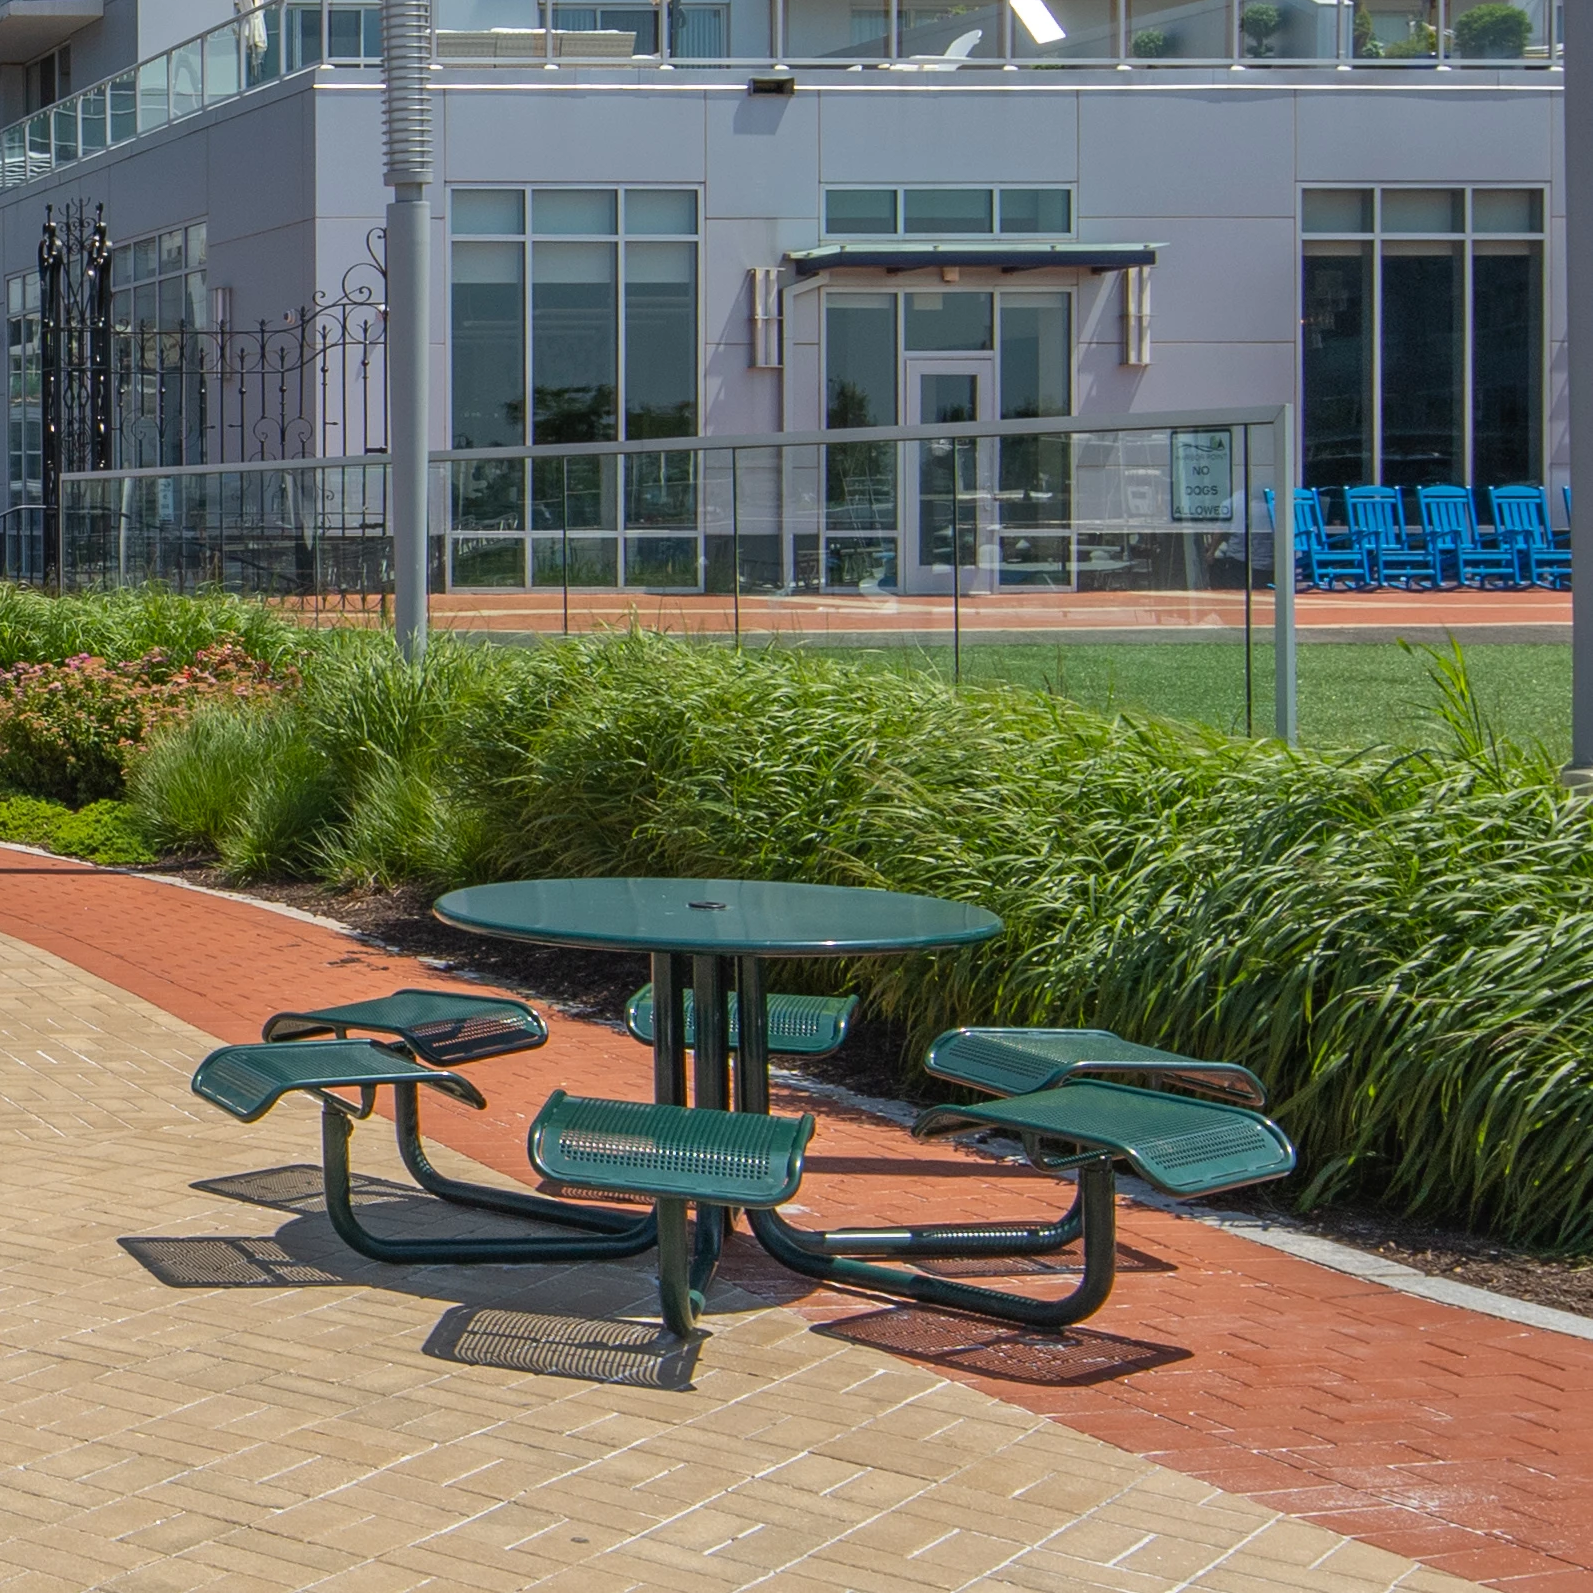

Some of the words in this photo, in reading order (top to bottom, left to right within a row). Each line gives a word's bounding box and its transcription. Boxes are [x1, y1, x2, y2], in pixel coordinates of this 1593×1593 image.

[1192, 465, 1210, 475] NO
[1185, 485, 1219, 495] DOGS
[1174, 505, 1230, 515] ALLOWED
